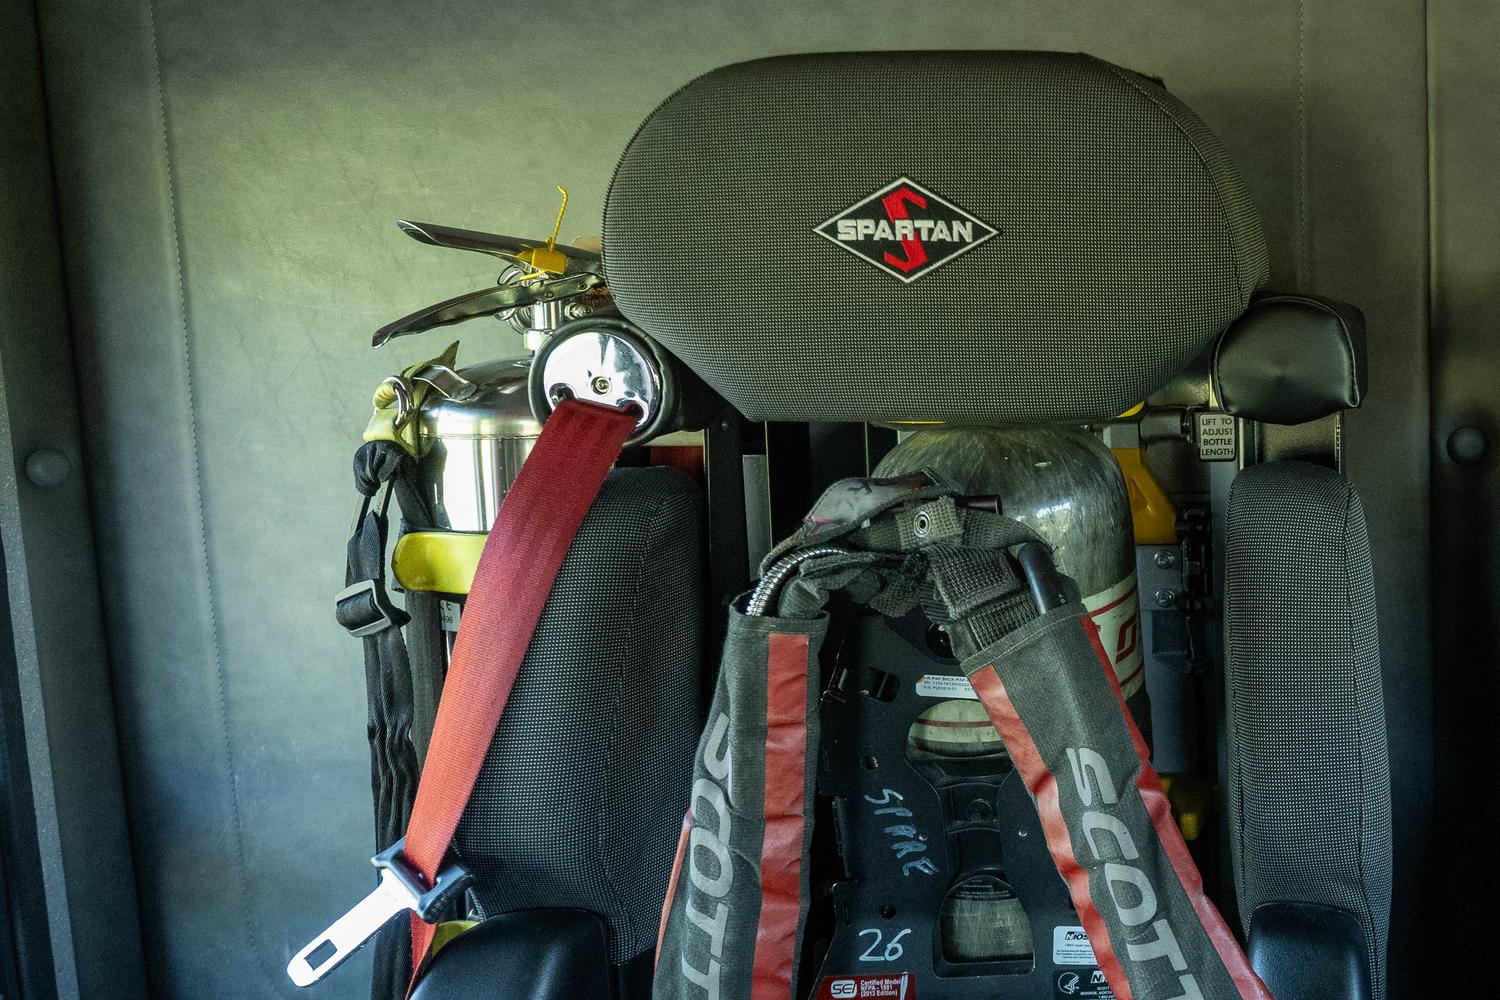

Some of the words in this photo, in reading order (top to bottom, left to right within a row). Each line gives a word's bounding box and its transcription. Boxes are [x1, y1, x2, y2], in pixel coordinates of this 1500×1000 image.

[837, 219, 973, 243] SPARTAN
[1202, 418, 1216, 426] LIFT
[1202, 428, 1233, 436] ADJUST
[1204, 438, 1232, 446] BOTTLE
[1202, 448, 1233, 456] LENGTH
[1065, 932, 1089, 941] NIOS
[858, 928, 912, 962] 26
[832, 984, 857, 995] SEI
